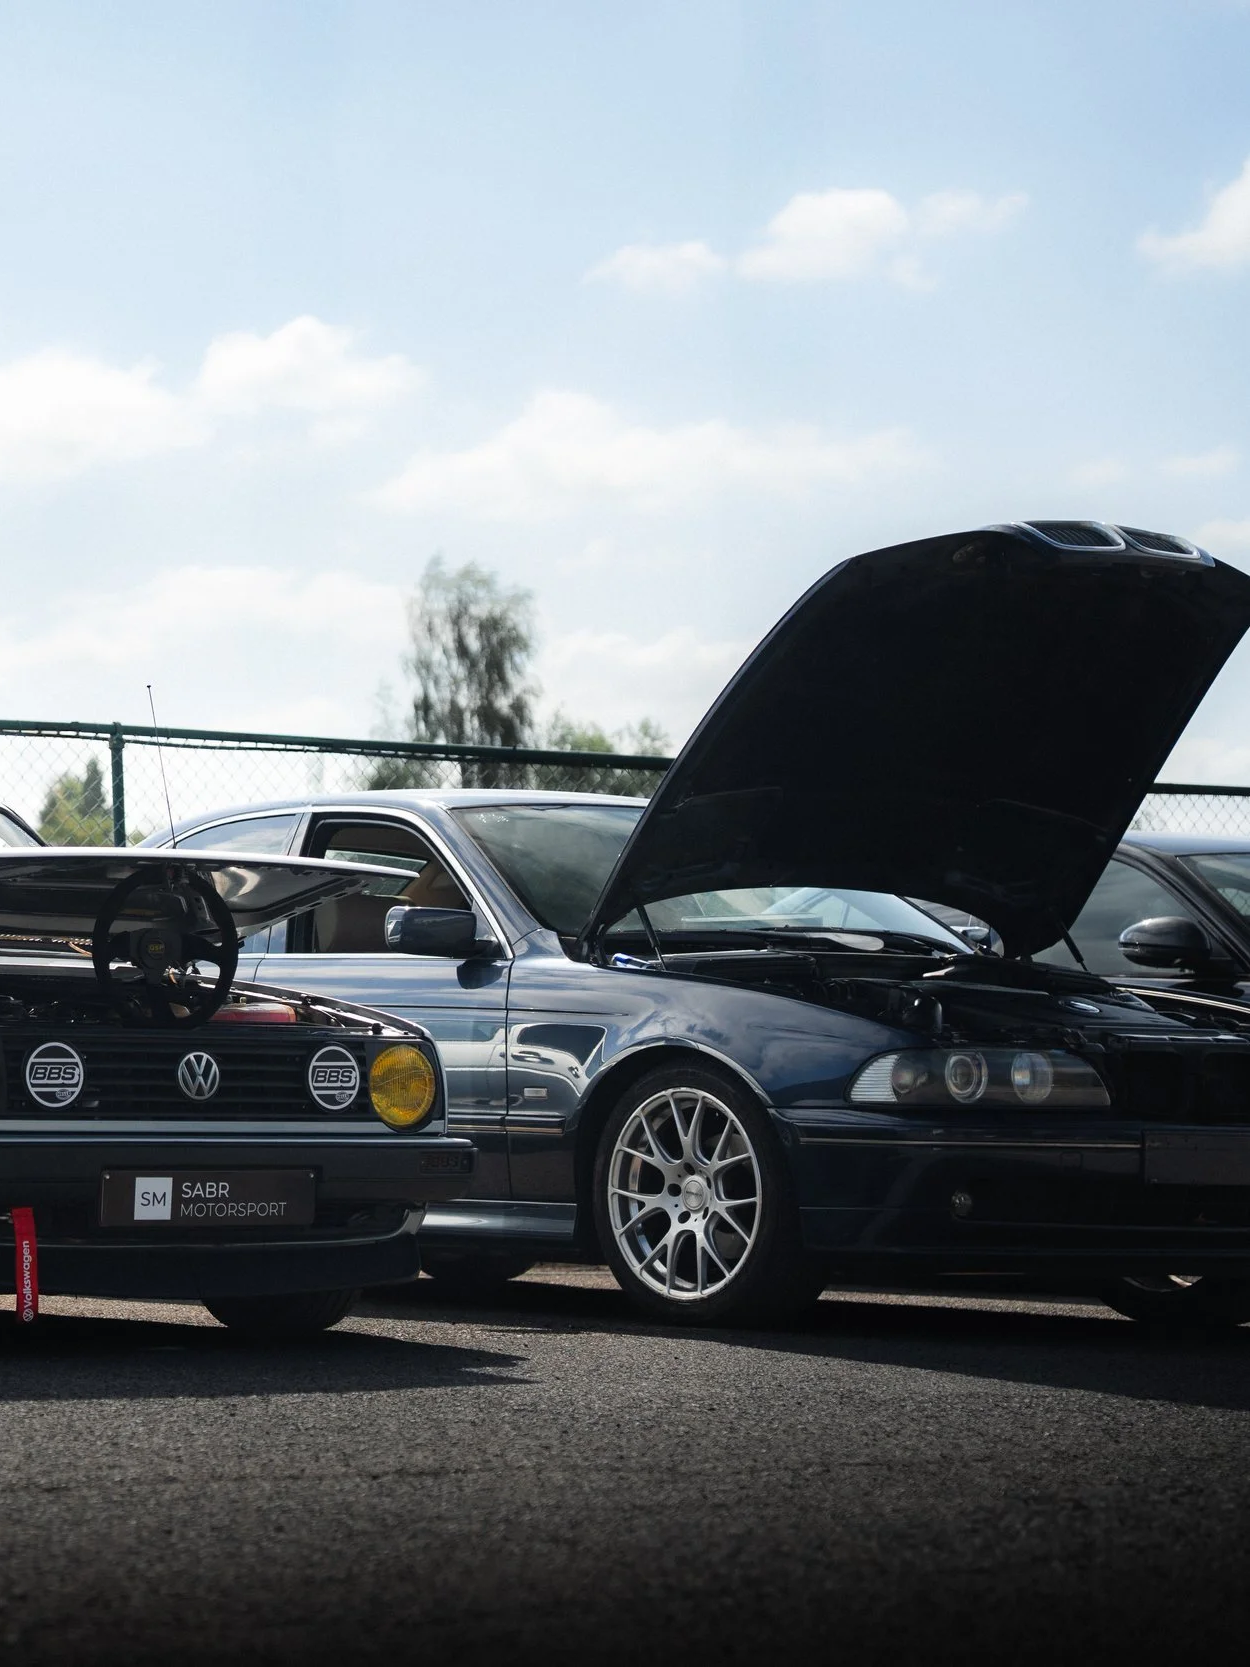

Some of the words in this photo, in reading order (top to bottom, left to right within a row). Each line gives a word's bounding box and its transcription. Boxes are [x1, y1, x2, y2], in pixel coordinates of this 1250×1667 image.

[30, 1065, 80, 1084] BBS
[313, 1069, 356, 1087] BBS
[181, 1182, 230, 1198] SABR
[140, 1191, 167, 1207] SM
[180, 1202, 287, 1217] MOTORSPORT
[22, 1240, 33, 1308] Volkswagen
